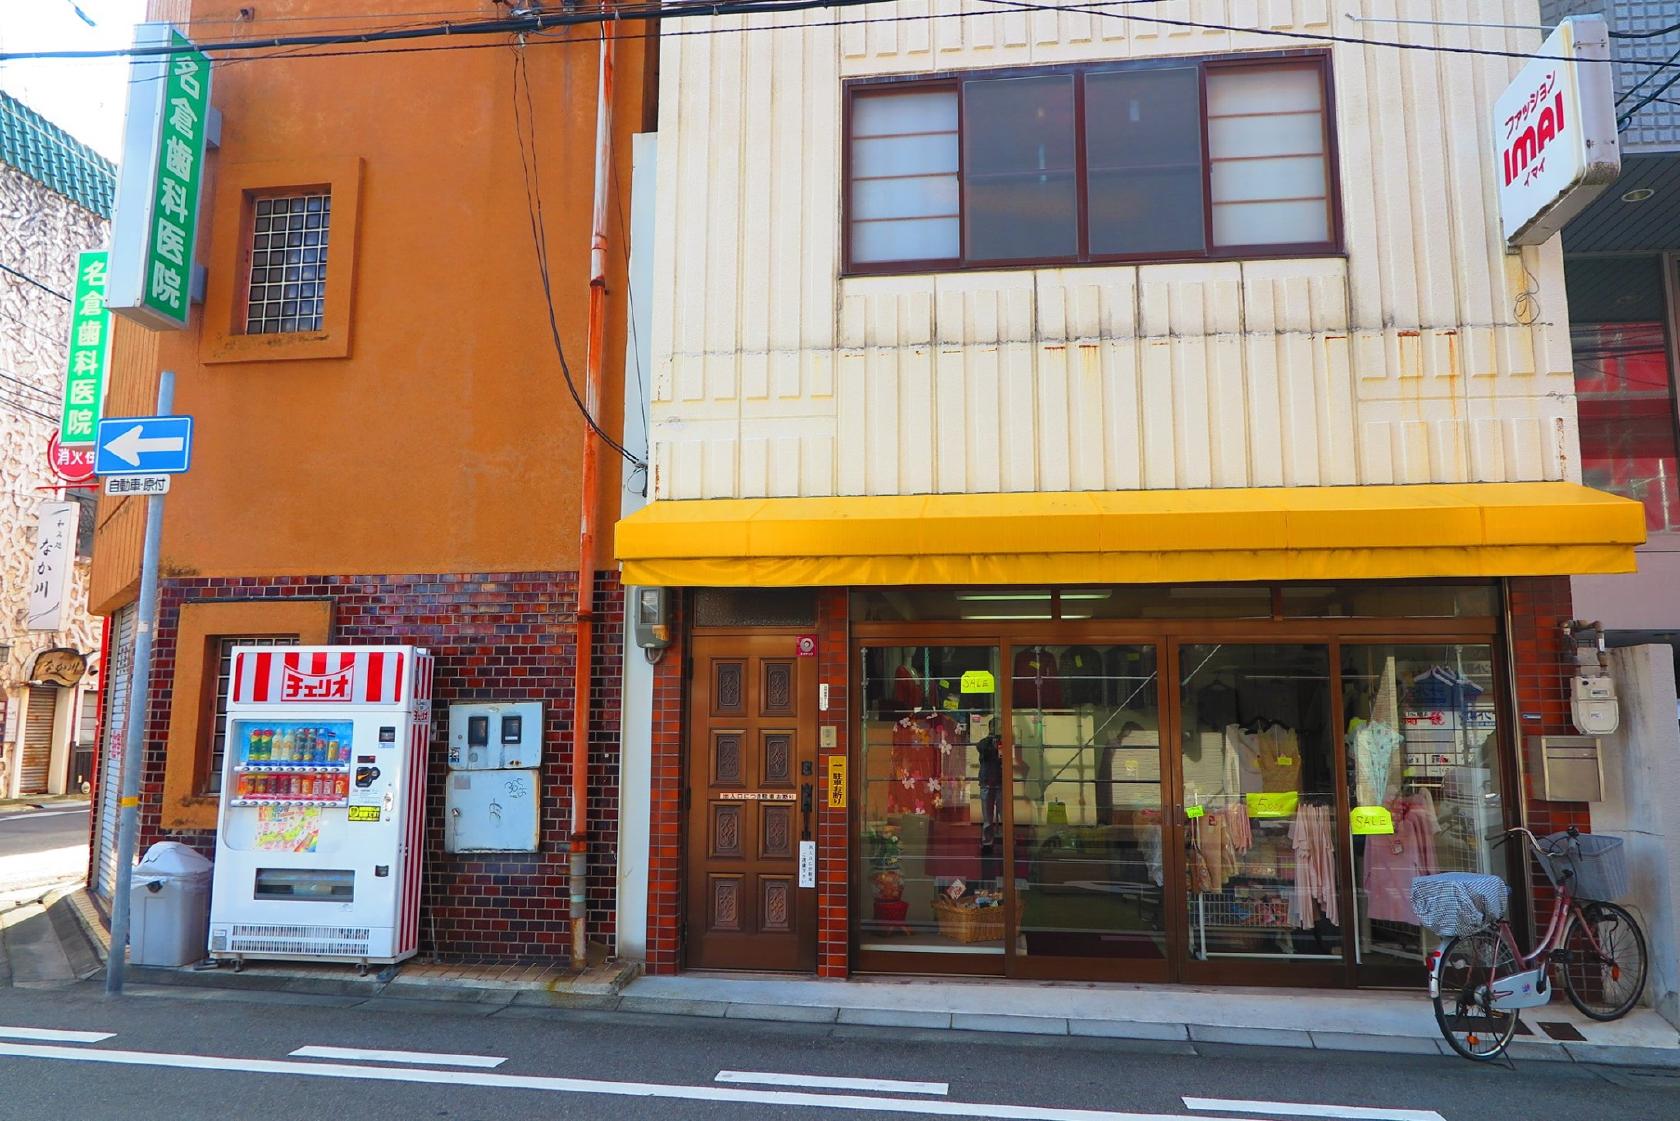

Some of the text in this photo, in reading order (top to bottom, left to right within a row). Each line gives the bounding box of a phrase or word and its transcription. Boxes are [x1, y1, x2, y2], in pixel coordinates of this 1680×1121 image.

[1504, 70, 1556, 140] ファッション
[1503, 90, 1565, 187] IMAI
[151, 55, 200, 309] 名倉歯科医院
[1524, 156, 1546, 187] イマイ
[67, 259, 106, 435] 名倉歯科医院
[34, 538, 53, 598] なか川
[286, 673, 349, 698] チェリオ
[962, 675, 990, 689] SALE
[1356, 815, 1387, 827] SALE
